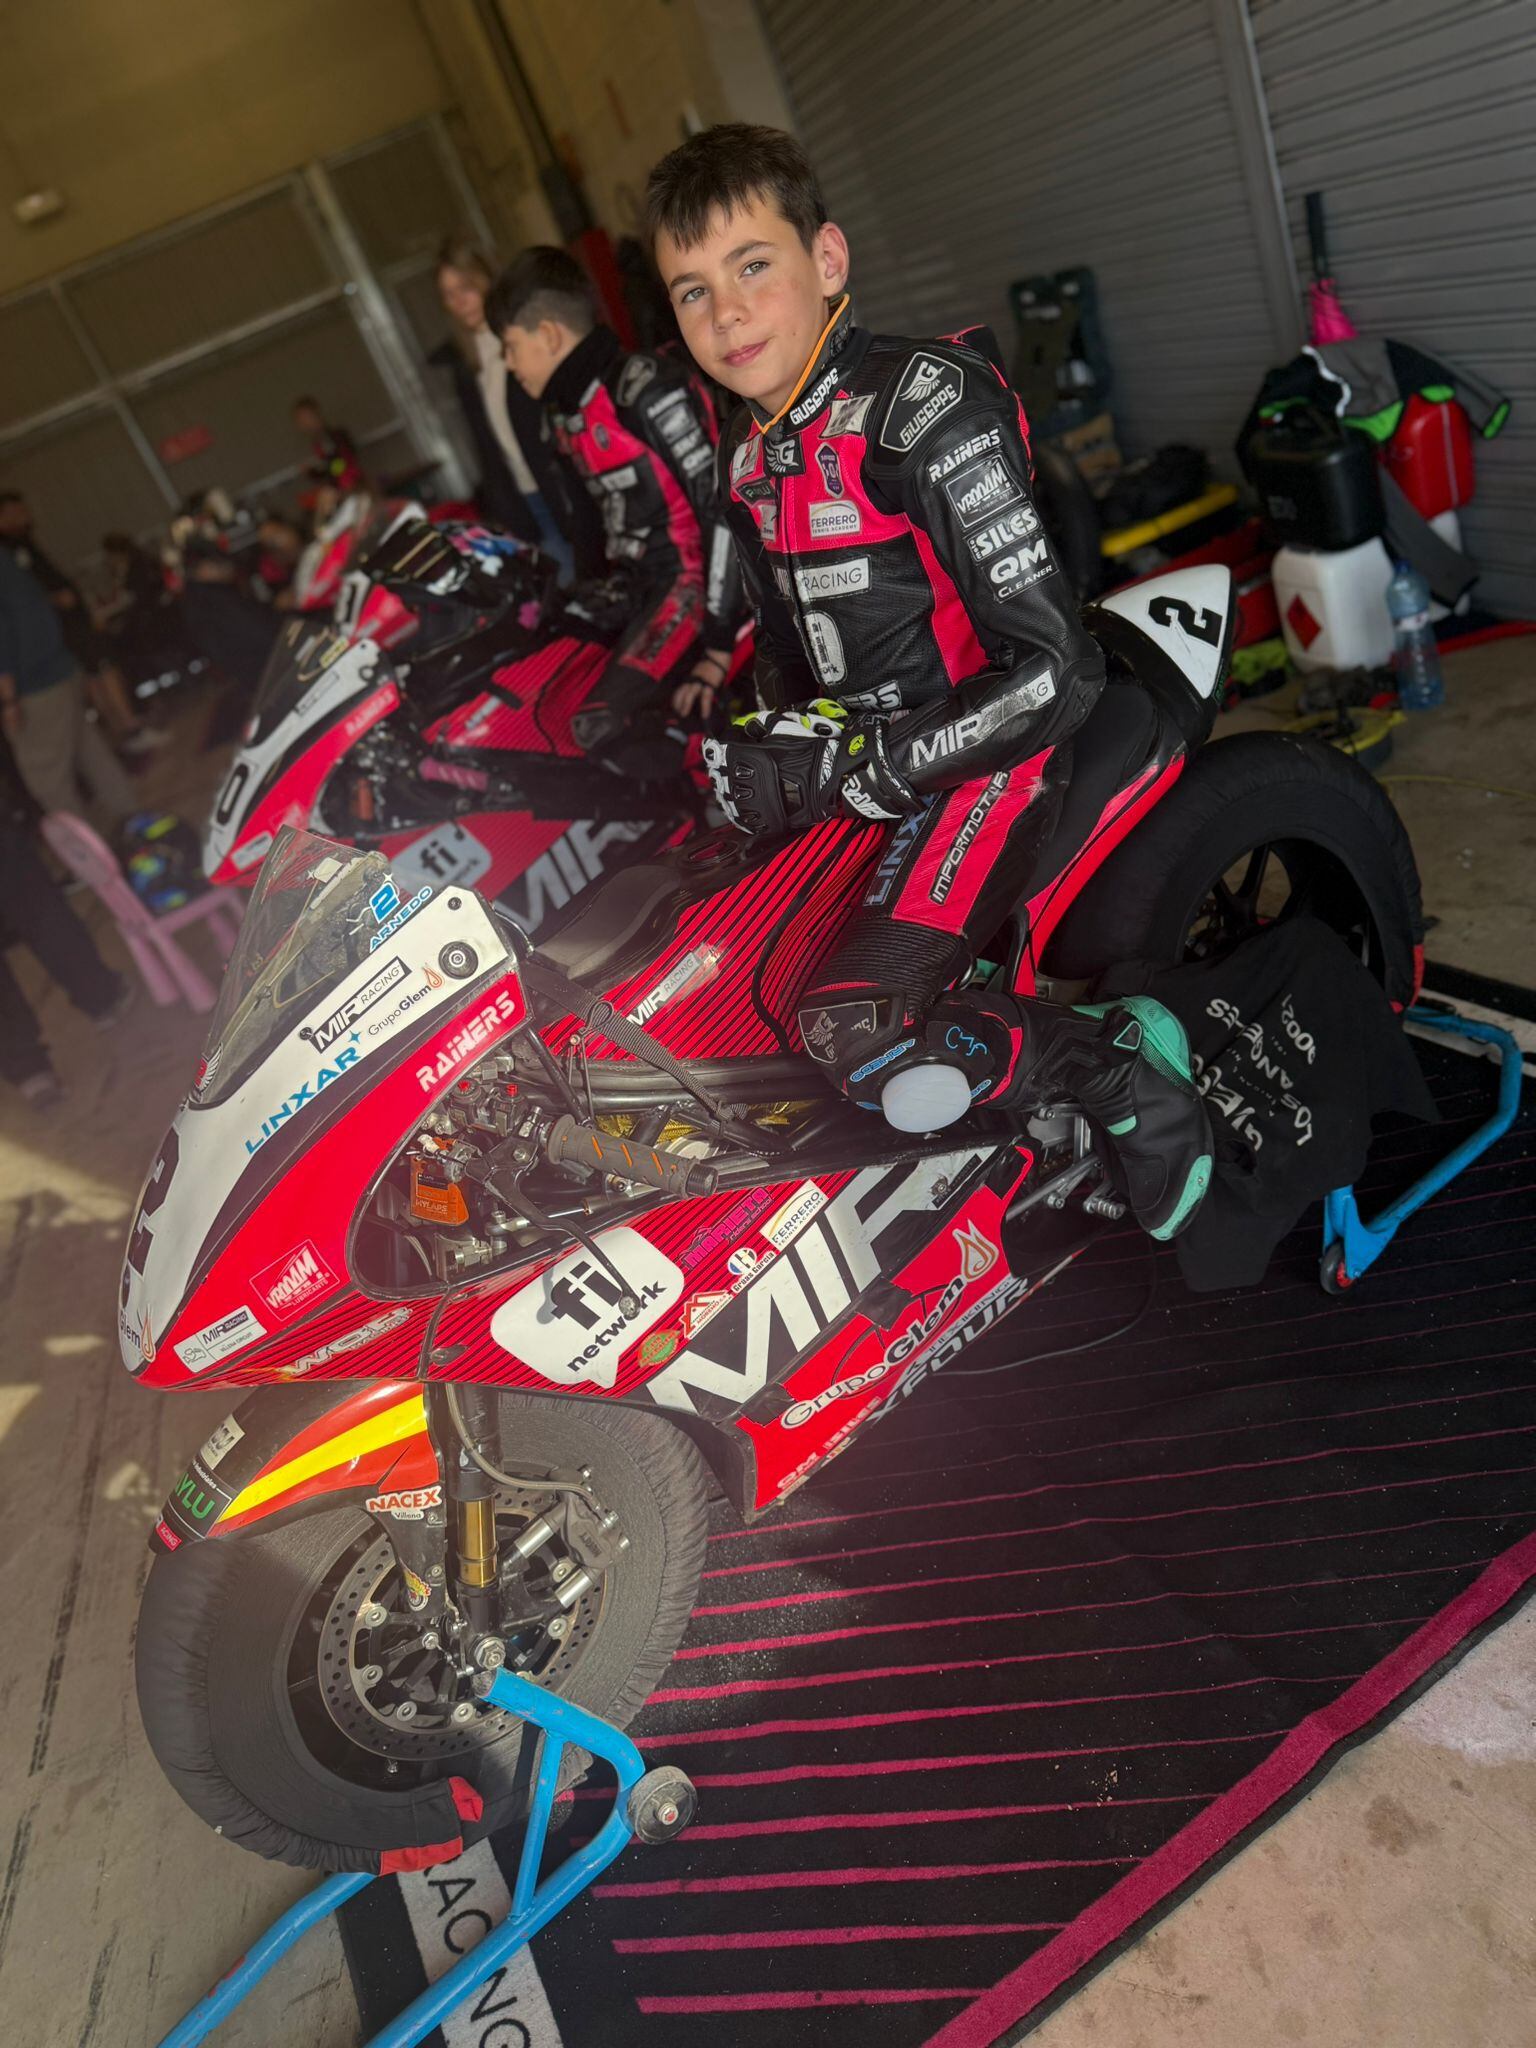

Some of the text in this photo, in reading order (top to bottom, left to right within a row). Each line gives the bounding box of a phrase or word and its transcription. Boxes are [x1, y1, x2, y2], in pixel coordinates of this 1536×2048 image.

[810, 513, 858, 530] FERRERO
[975, 507, 1038, 558] SILES
[803, 567, 863, 592] RACING
[989, 538, 1049, 585] QM
[1147, 595, 1224, 649] 2
[911, 712, 984, 770] MIR
[368, 881, 401, 924] 2
[369, 885, 434, 954] ARNEDO
[663, 958, 695, 993] RACING
[315, 965, 401, 1051] MIR RACING
[244, 1046, 362, 1156] LINXAR
[683, 1186, 771, 1269] MARIETA
[771, 1191, 821, 1244] FERRERO
[289, 1278, 329, 1307] LUBRICANTS
[550, 1260, 623, 1331] fi
[645, 1148, 965, 1418] MIR
[202, 1323, 229, 1346] MIR
[175, 1472, 216, 1520] YLU
[368, 1488, 439, 1512] NACEX
[394, 1511, 422, 1520] Villena
